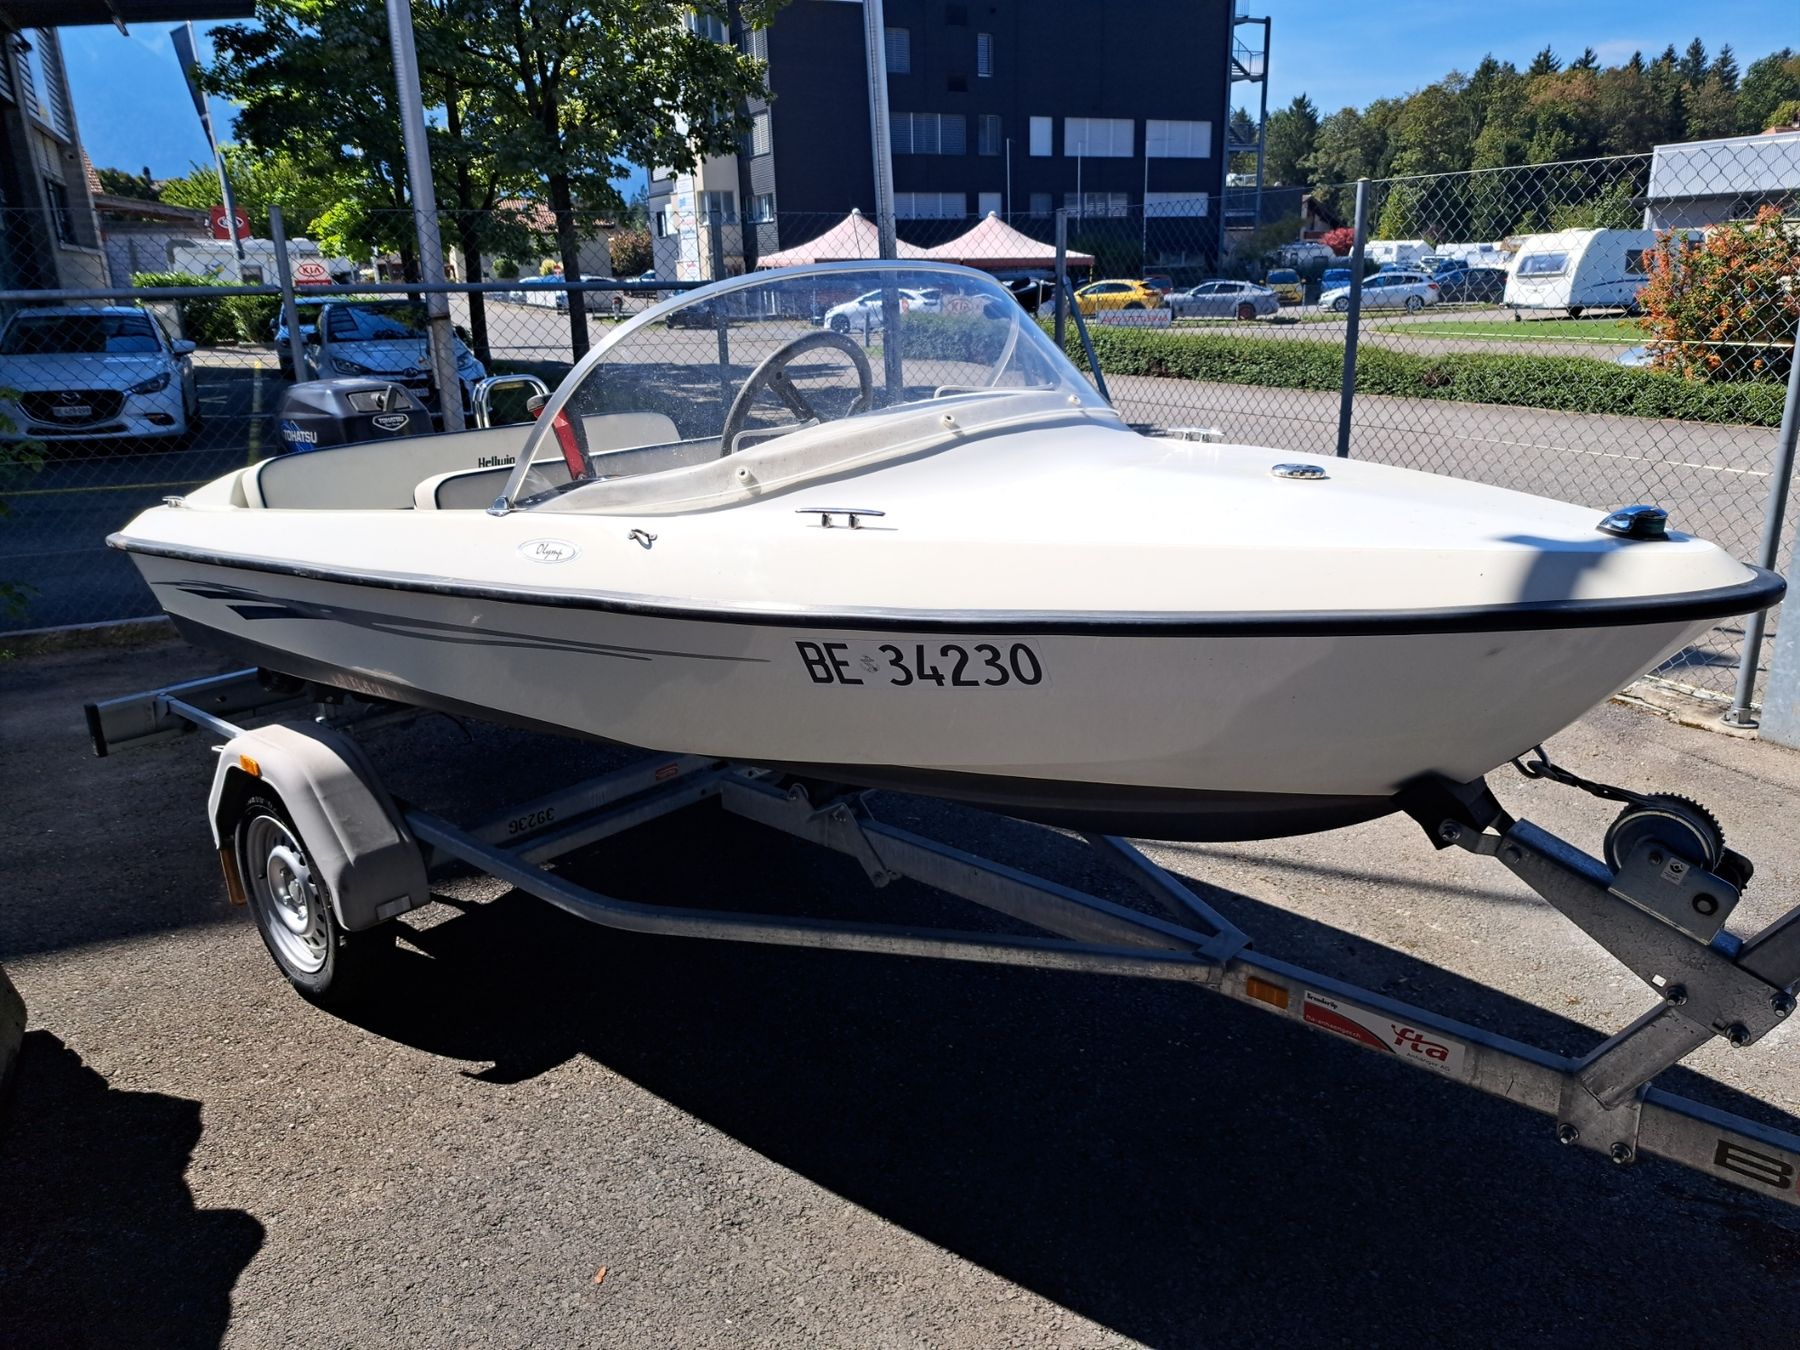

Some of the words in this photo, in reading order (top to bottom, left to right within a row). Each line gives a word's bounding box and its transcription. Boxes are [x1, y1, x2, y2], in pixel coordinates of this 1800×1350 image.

[283, 429, 318, 444] TOHATSU
[795, 641, 864, 685] BE
[878, 643, 1043, 686] 34230
[1391, 1024, 1449, 1062] fta
[1713, 1139, 1800, 1197] B
